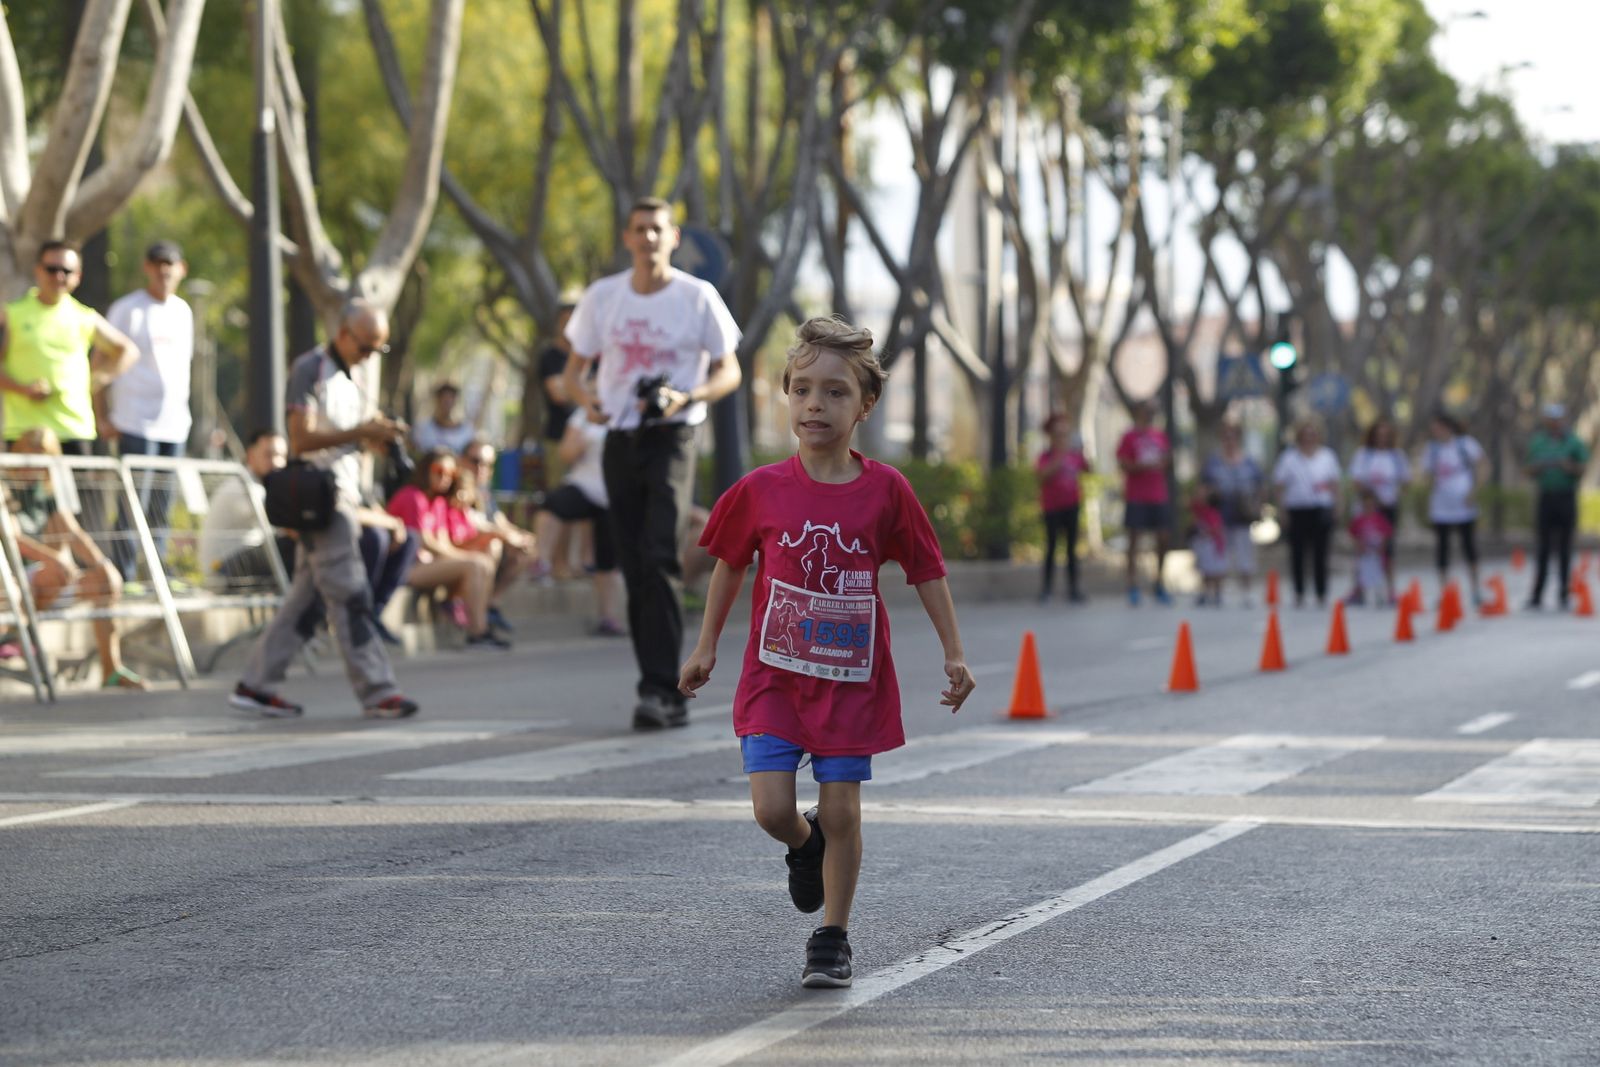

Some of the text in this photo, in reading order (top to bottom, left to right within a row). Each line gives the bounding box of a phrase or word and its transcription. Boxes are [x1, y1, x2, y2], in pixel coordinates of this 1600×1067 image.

[833, 570, 846, 595] 4
[814, 598, 844, 609] CARRERA
[799, 618, 870, 648] 1595
[809, 645, 853, 658] ALEJANDRO
